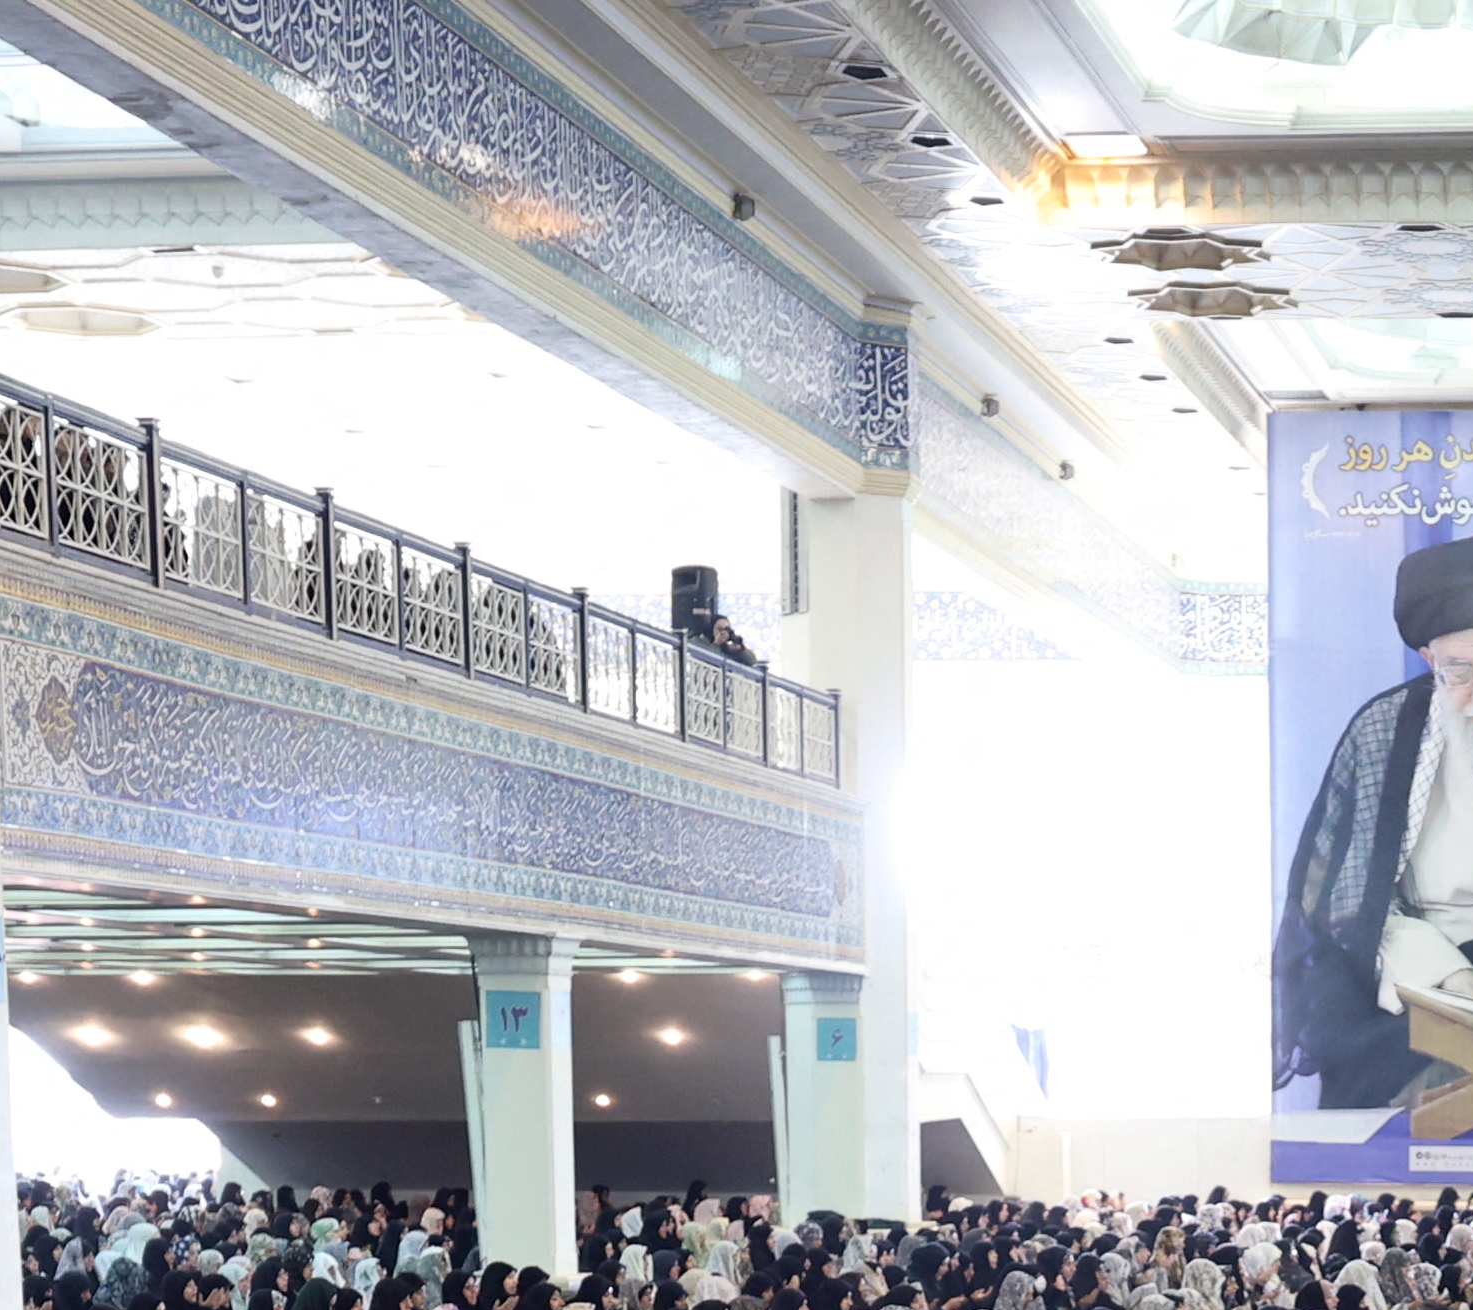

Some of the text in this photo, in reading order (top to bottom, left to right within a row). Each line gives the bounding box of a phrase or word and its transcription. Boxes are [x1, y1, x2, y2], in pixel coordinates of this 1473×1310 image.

[1338, 434, 1388, 472] روز
[1392, 440, 1435, 473] هر
[499, 1005, 529, 1034] ۱۳
[829, 1028, 844, 1049] ۶
